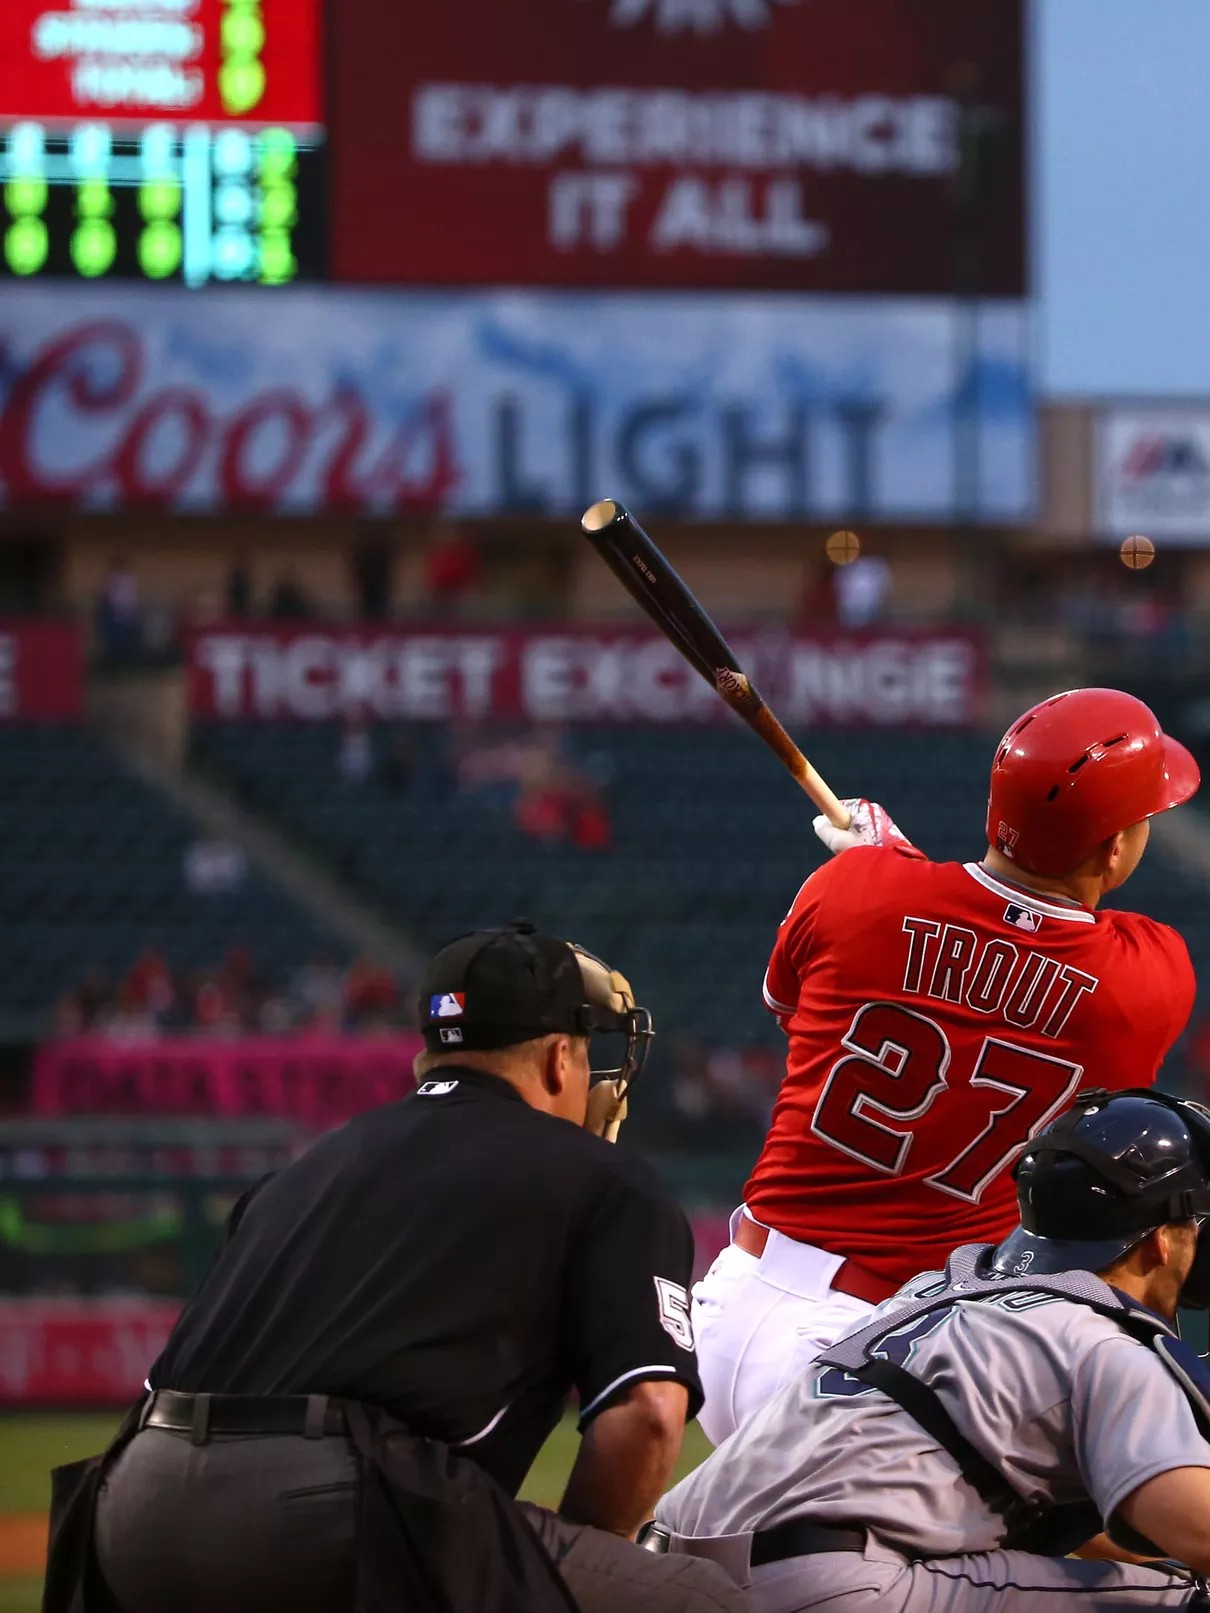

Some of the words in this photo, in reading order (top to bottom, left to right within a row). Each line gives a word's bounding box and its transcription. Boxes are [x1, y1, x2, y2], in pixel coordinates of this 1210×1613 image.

[413, 80, 957, 174] EXPERIENCE
[549, 173, 636, 250] IT
[653, 177, 826, 255] ALL
[0, 315, 460, 508] Coors
[492, 392, 890, 522] LIGHT
[197, 634, 502, 720] TICKET
[522, 636, 974, 722] EXCNGE
[997, 820, 1020, 847] 27
[902, 916, 1099, 1039] TROUT
[810, 1001, 1084, 1205] 27
[1013, 1251, 1035, 1275] 3
[653, 1275, 695, 1352] 5
